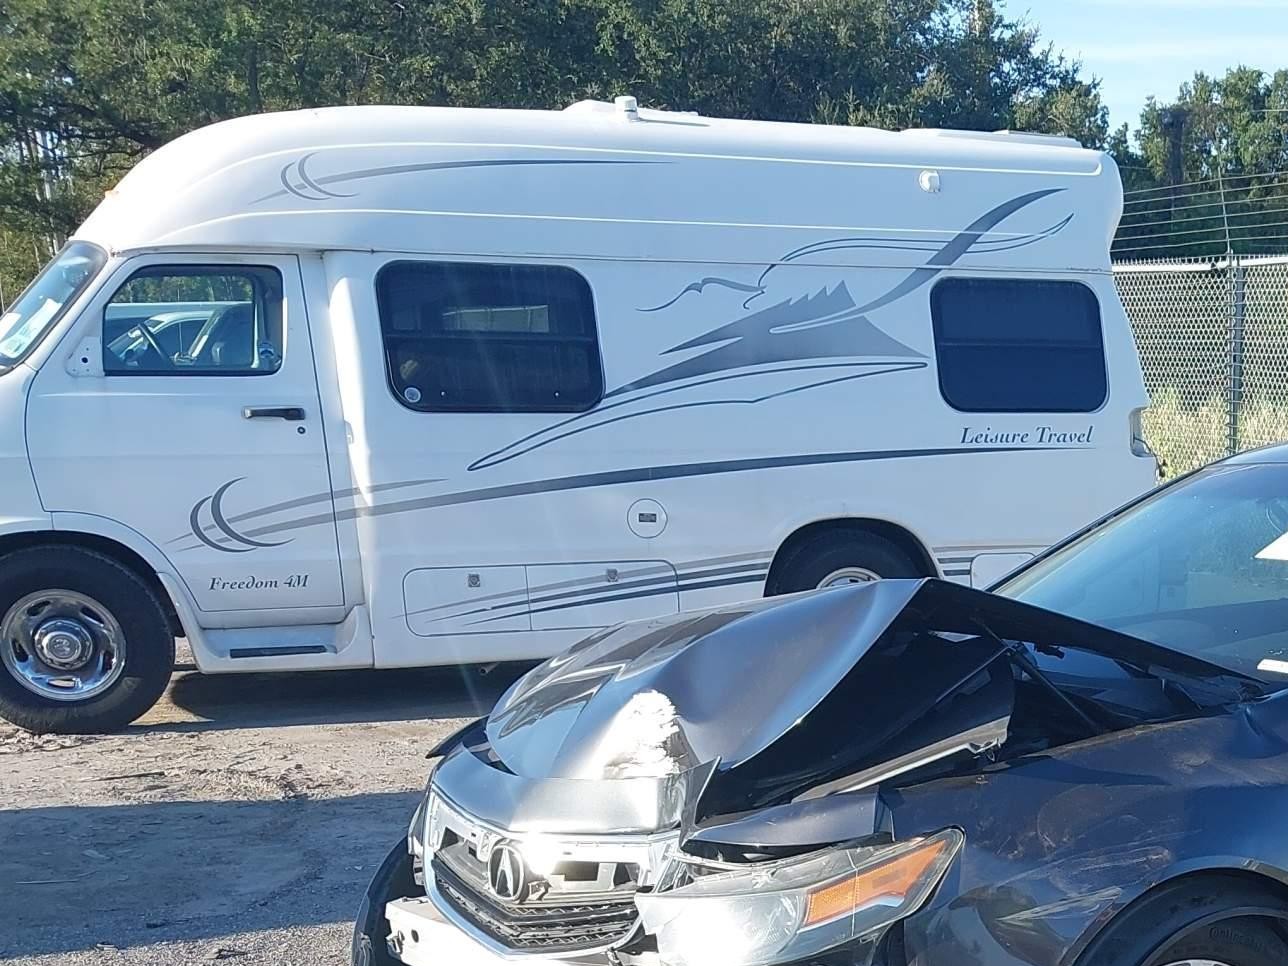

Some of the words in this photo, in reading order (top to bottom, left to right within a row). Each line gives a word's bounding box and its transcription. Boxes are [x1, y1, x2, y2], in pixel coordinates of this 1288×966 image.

[960, 426, 1030, 444] Leisure
[1036, 425, 1094, 443] Travel
[208, 575, 279, 591] Freedom
